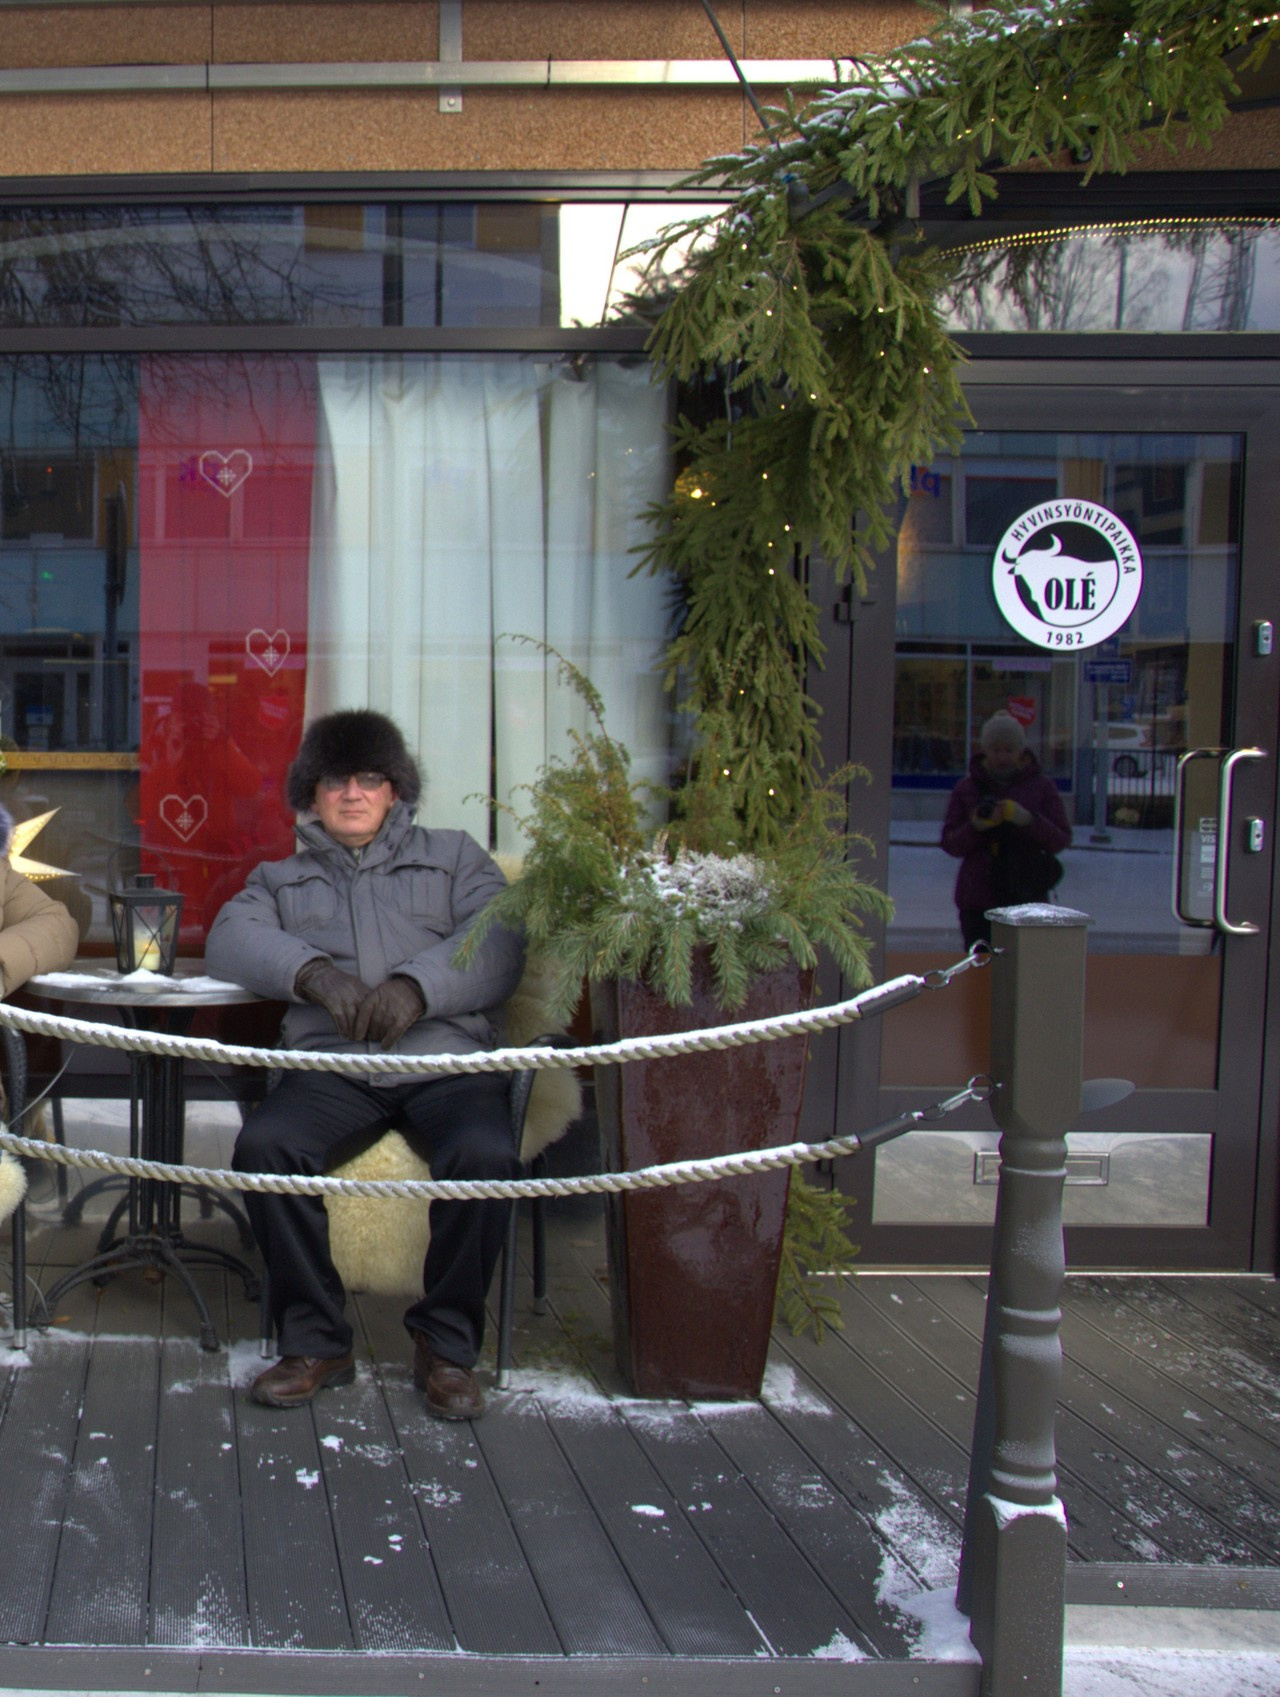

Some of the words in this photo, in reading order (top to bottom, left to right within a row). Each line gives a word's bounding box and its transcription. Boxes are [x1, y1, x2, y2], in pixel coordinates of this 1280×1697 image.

[1011, 503, 1136, 575] HYVINSYÖNTIPAIKKA
[1044, 572, 1096, 610] OLÉ
[1046, 631, 1084, 645] 1982
